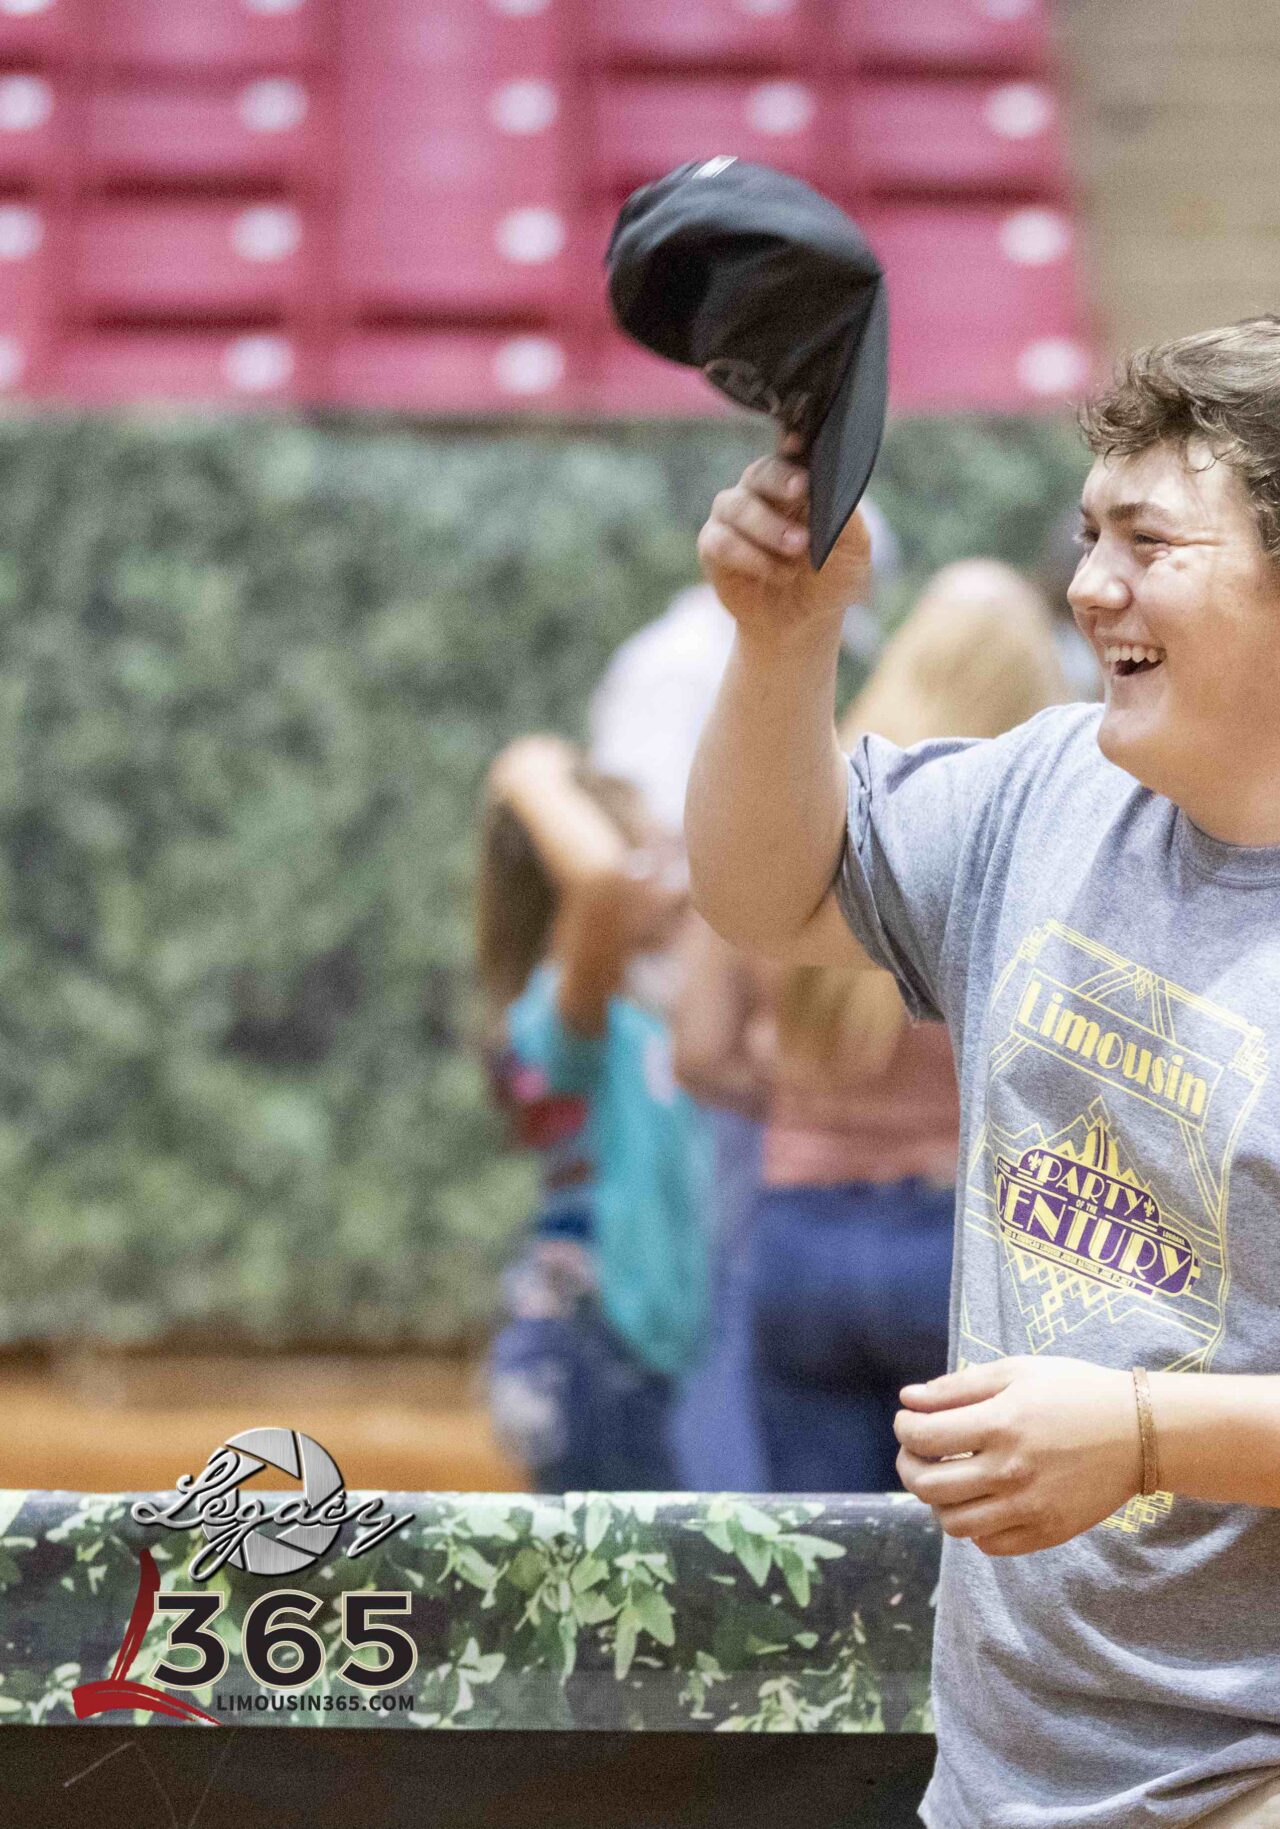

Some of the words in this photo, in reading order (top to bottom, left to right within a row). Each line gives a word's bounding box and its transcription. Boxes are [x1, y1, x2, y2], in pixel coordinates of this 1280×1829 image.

[1017, 979, 1207, 1116] Limousin
[996, 1173, 1191, 1286] CENTURY
[1036, 1154, 1144, 1217] PARTY
[1075, 1198, 1085, 1208] OF
[1085, 1201, 1098, 1214] THE
